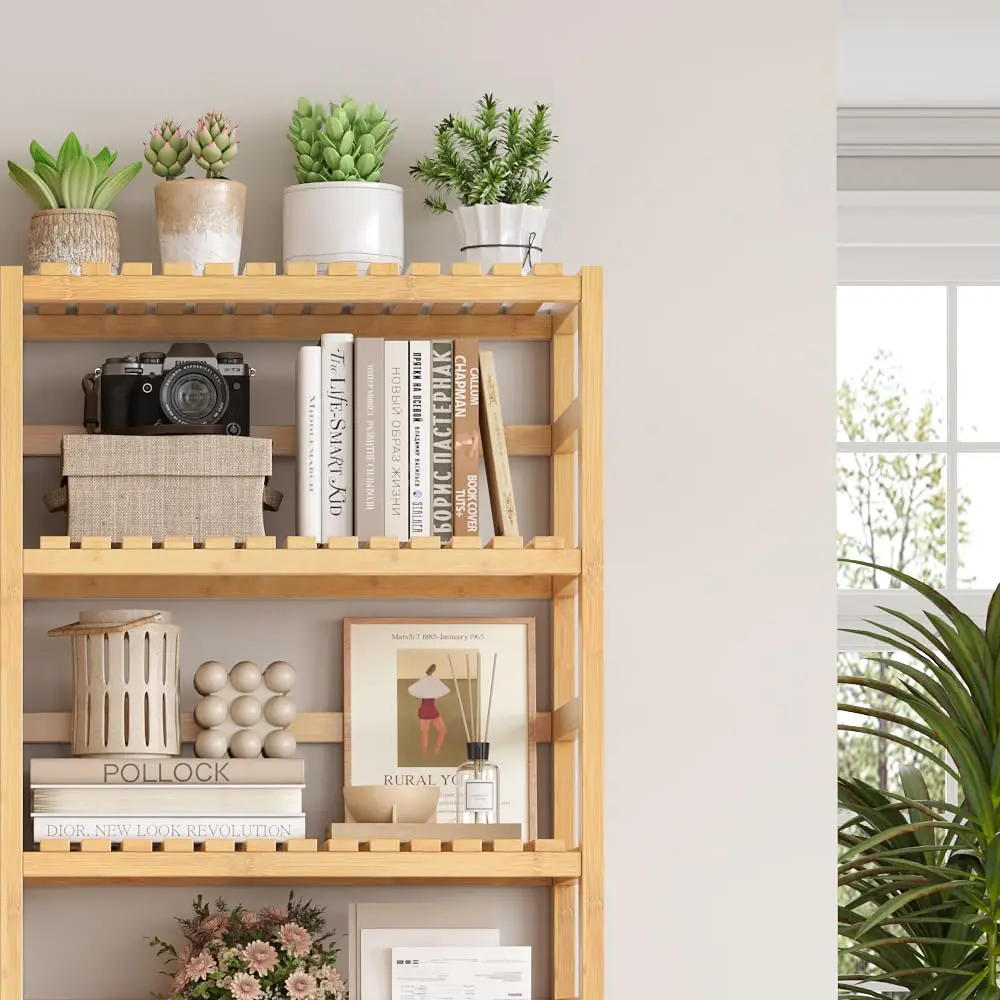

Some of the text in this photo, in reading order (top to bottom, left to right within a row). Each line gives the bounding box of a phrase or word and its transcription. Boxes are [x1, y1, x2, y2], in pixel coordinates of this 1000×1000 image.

[412, 352, 422, 380] ПРЯТКИ
[412, 382, 422, 393] НА
[454, 354, 467, 418] CHAPMAN
[470, 367, 478, 406] CALLUM
[412, 395, 423, 422] ОСЕВОЙ
[391, 367, 402, 516] НОВЫЙ ОБРАЗ ЖИЗНИ
[433, 349, 452, 533] БОРИС ПАСТЕРНАК
[455, 488, 465, 518] TUTS+
[466, 474, 478, 532] BOOK COVER
[103, 762, 230, 783] POLLOCK
[383, 774, 437, 786] RURAL
[95, 824, 132, 838] NEW
[136, 824, 186, 838] LOOK
[187, 824, 292, 838] REVOLUTION
